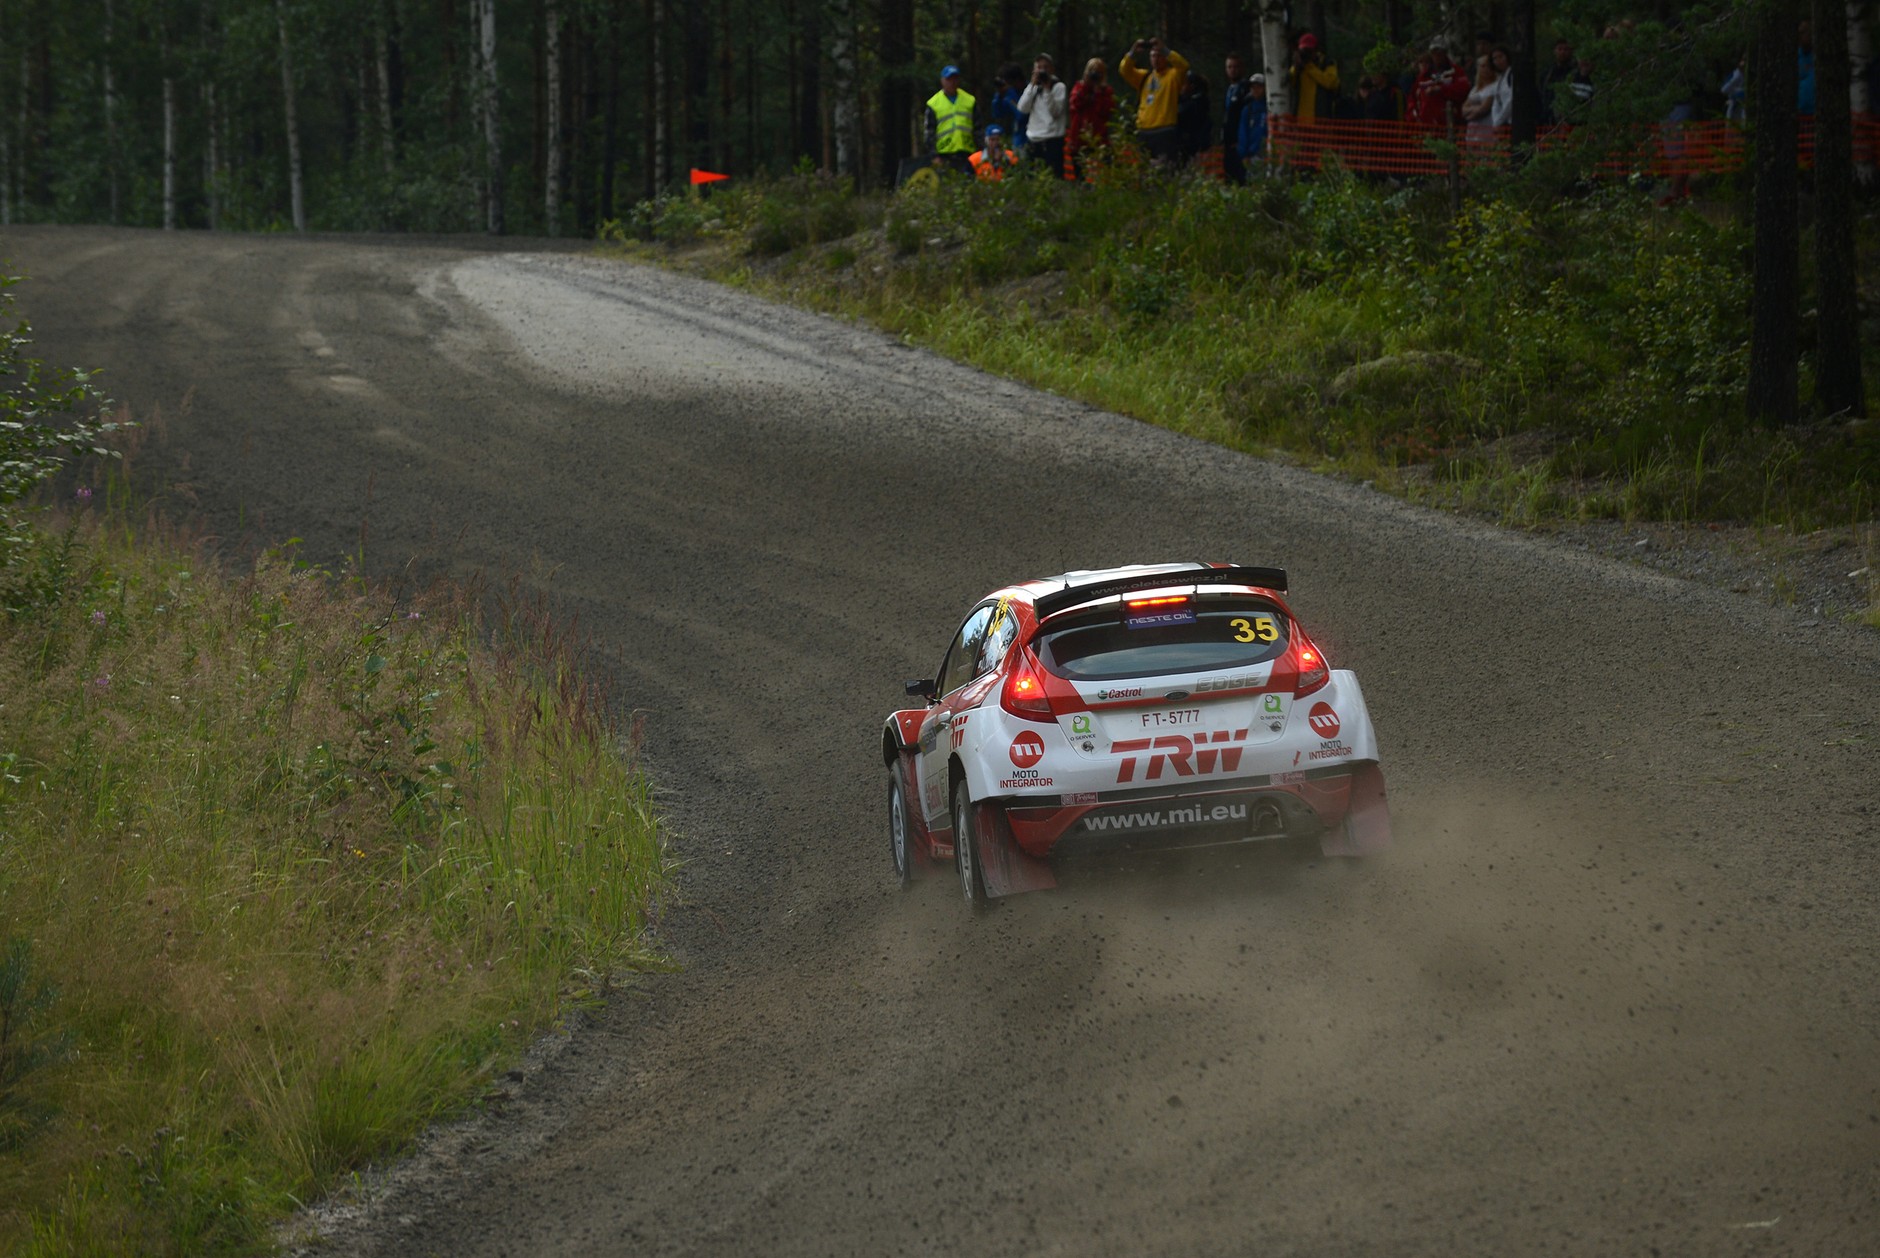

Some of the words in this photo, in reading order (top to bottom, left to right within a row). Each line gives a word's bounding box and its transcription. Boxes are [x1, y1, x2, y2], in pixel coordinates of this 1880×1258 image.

[1090, 574, 1228, 596] www.oleksowicz.pl
[1129, 614, 1171, 625] NESTE
[1174, 612, 1193, 620] OIL
[1230, 617, 1279, 643] 35
[1195, 671, 1262, 692] EDGE
[1108, 687, 1142, 699] Castrol
[1141, 709, 1200, 727] FT-5777
[1075, 733, 1097, 741] SERVICE
[1320, 740, 1342, 749] MOTO
[1110, 728, 1249, 784] TRW
[1309, 746, 1353, 760] INTEGRATOR
[1012, 770, 1039, 779] MOTO
[1000, 777, 1053, 789] INTEGRATOR
[1083, 804, 1247, 831] www.mi.eu
